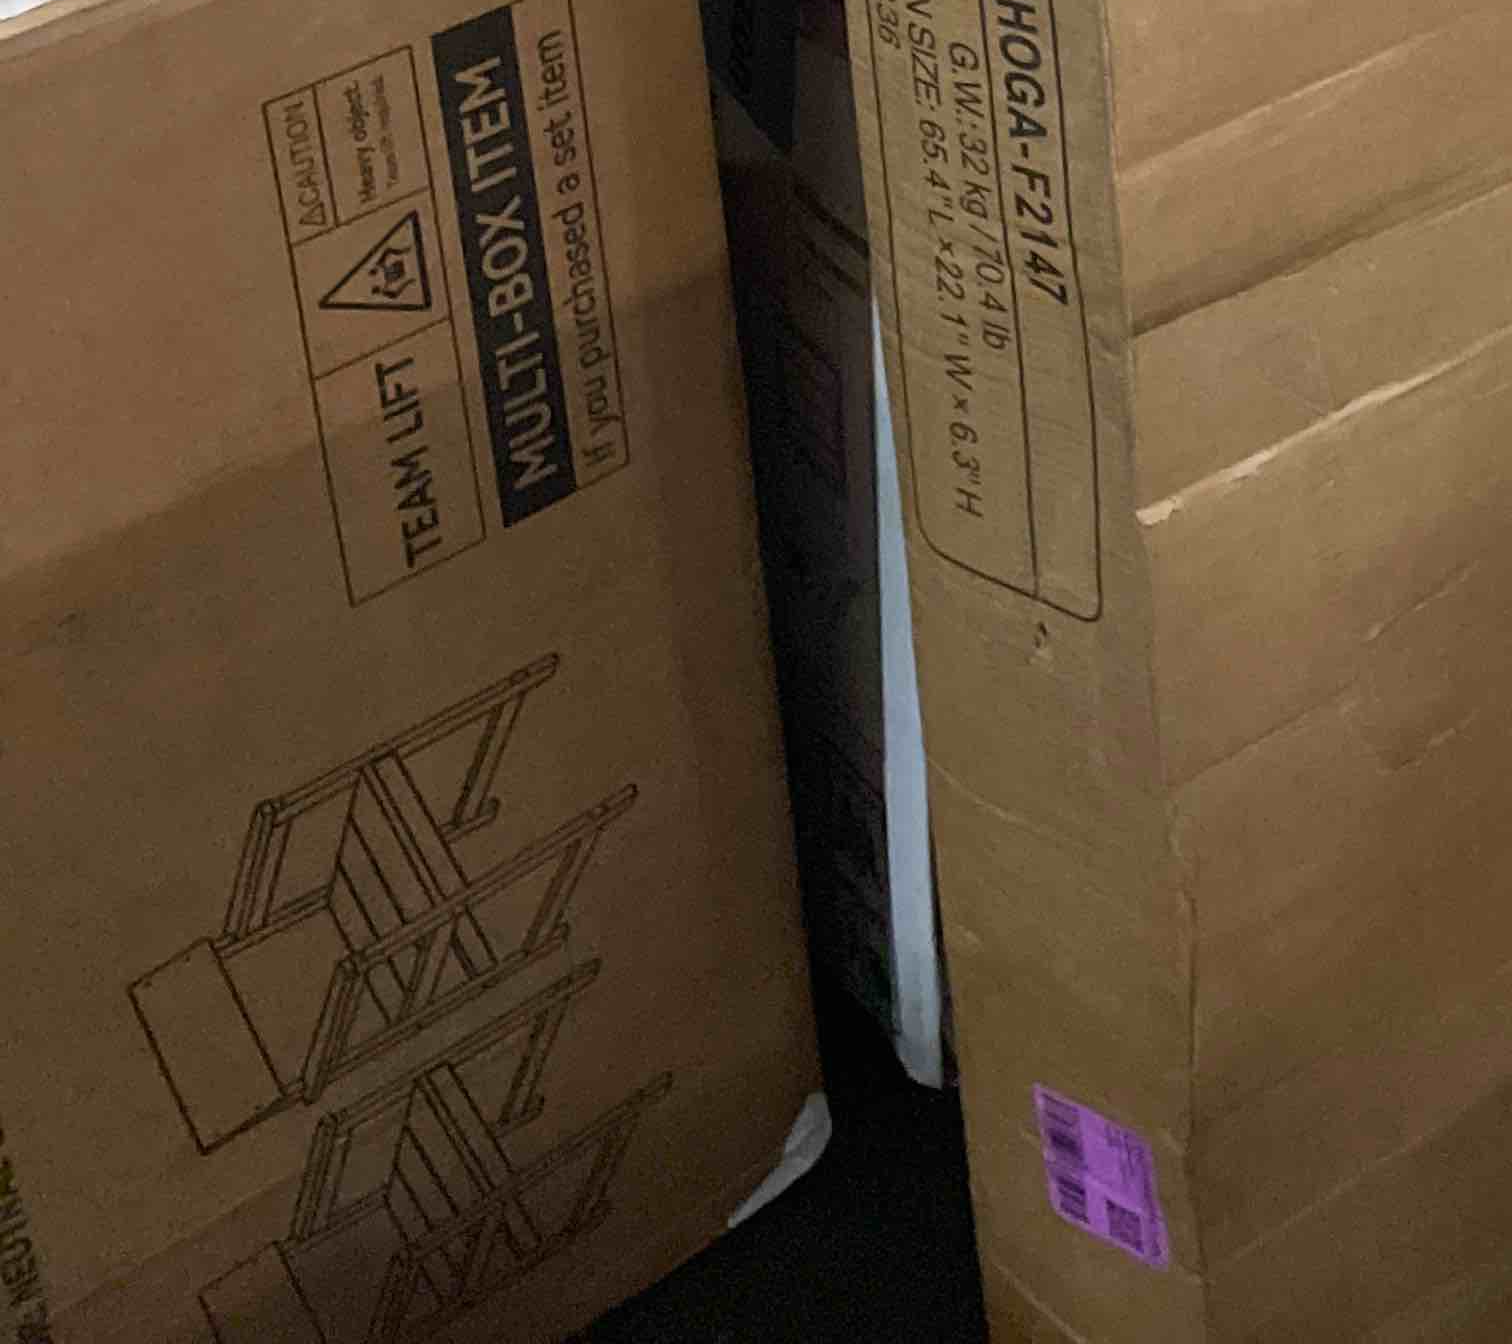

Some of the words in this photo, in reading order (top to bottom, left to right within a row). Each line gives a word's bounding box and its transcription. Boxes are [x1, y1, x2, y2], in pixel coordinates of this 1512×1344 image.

[536, 29, 569, 111] item
[907, 23, 942, 112] SIZE:
[454, 55, 517, 192] ITEM
[544, 111, 577, 167] set
[959, 133, 990, 175] 32
[557, 173, 580, 194] a
[959, 178, 992, 220] kg
[552, 201, 611, 370] purchased
[971, 244, 1010, 313] 70.4
[475, 194, 557, 490] MULTI-BOX
[982, 319, 1012, 350] lb
[375, 356, 424, 444] LIFT
[944, 353, 973, 392] W
[584, 373, 623, 437] you
[581, 440, 617, 467] If
[390, 445, 443, 568] TEAM
[955, 487, 985, 519] H
